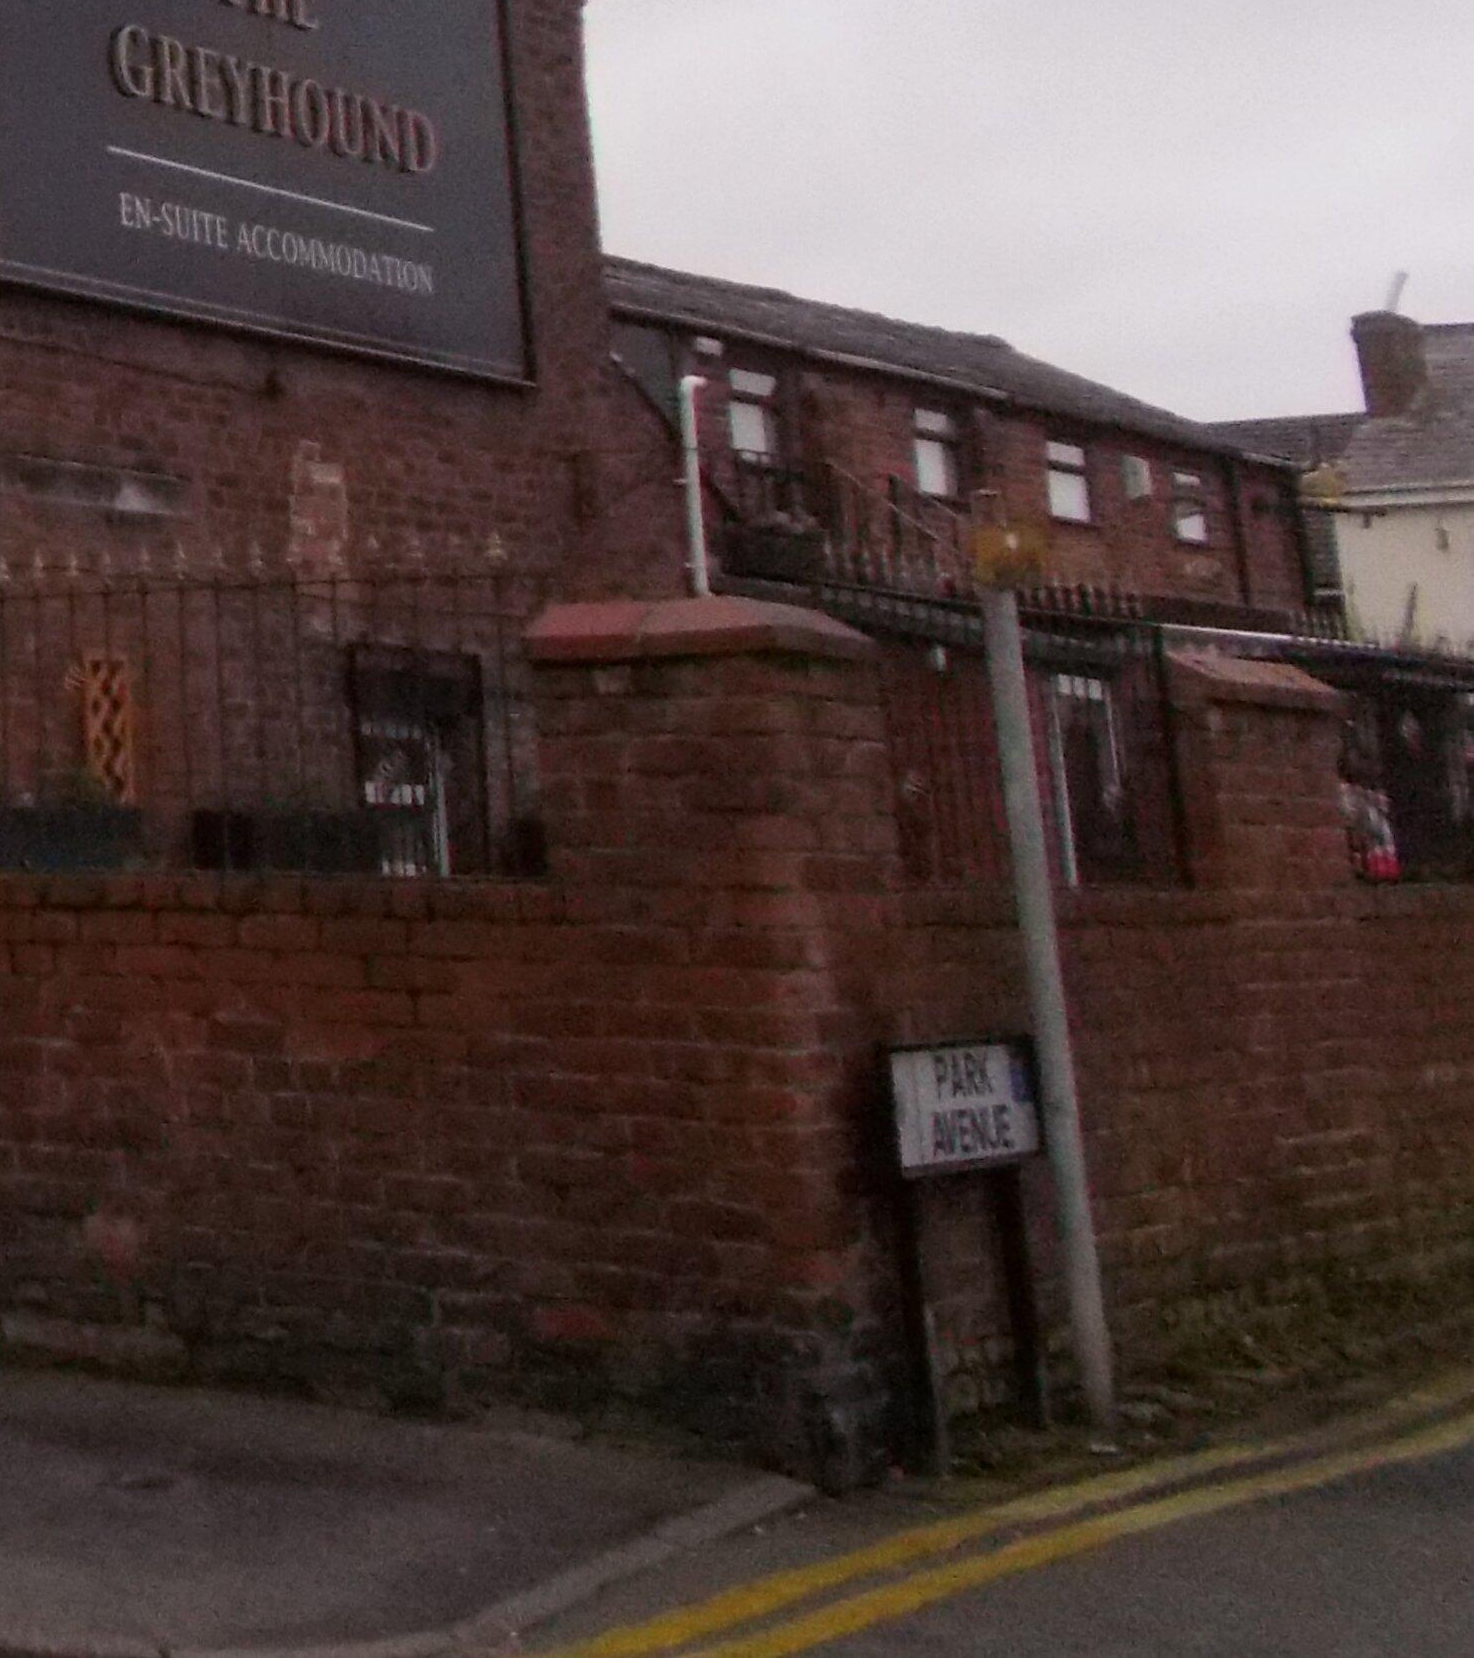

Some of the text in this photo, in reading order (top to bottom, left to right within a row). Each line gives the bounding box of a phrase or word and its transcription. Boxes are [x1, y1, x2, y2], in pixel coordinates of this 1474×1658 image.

[109, 23, 441, 174] GREYHOUND
[119, 191, 435, 294] EN-SUITE ACCOMMODATION
[933, 1050, 994, 1100] PARK
[932, 1103, 1015, 1157] AVENUE
